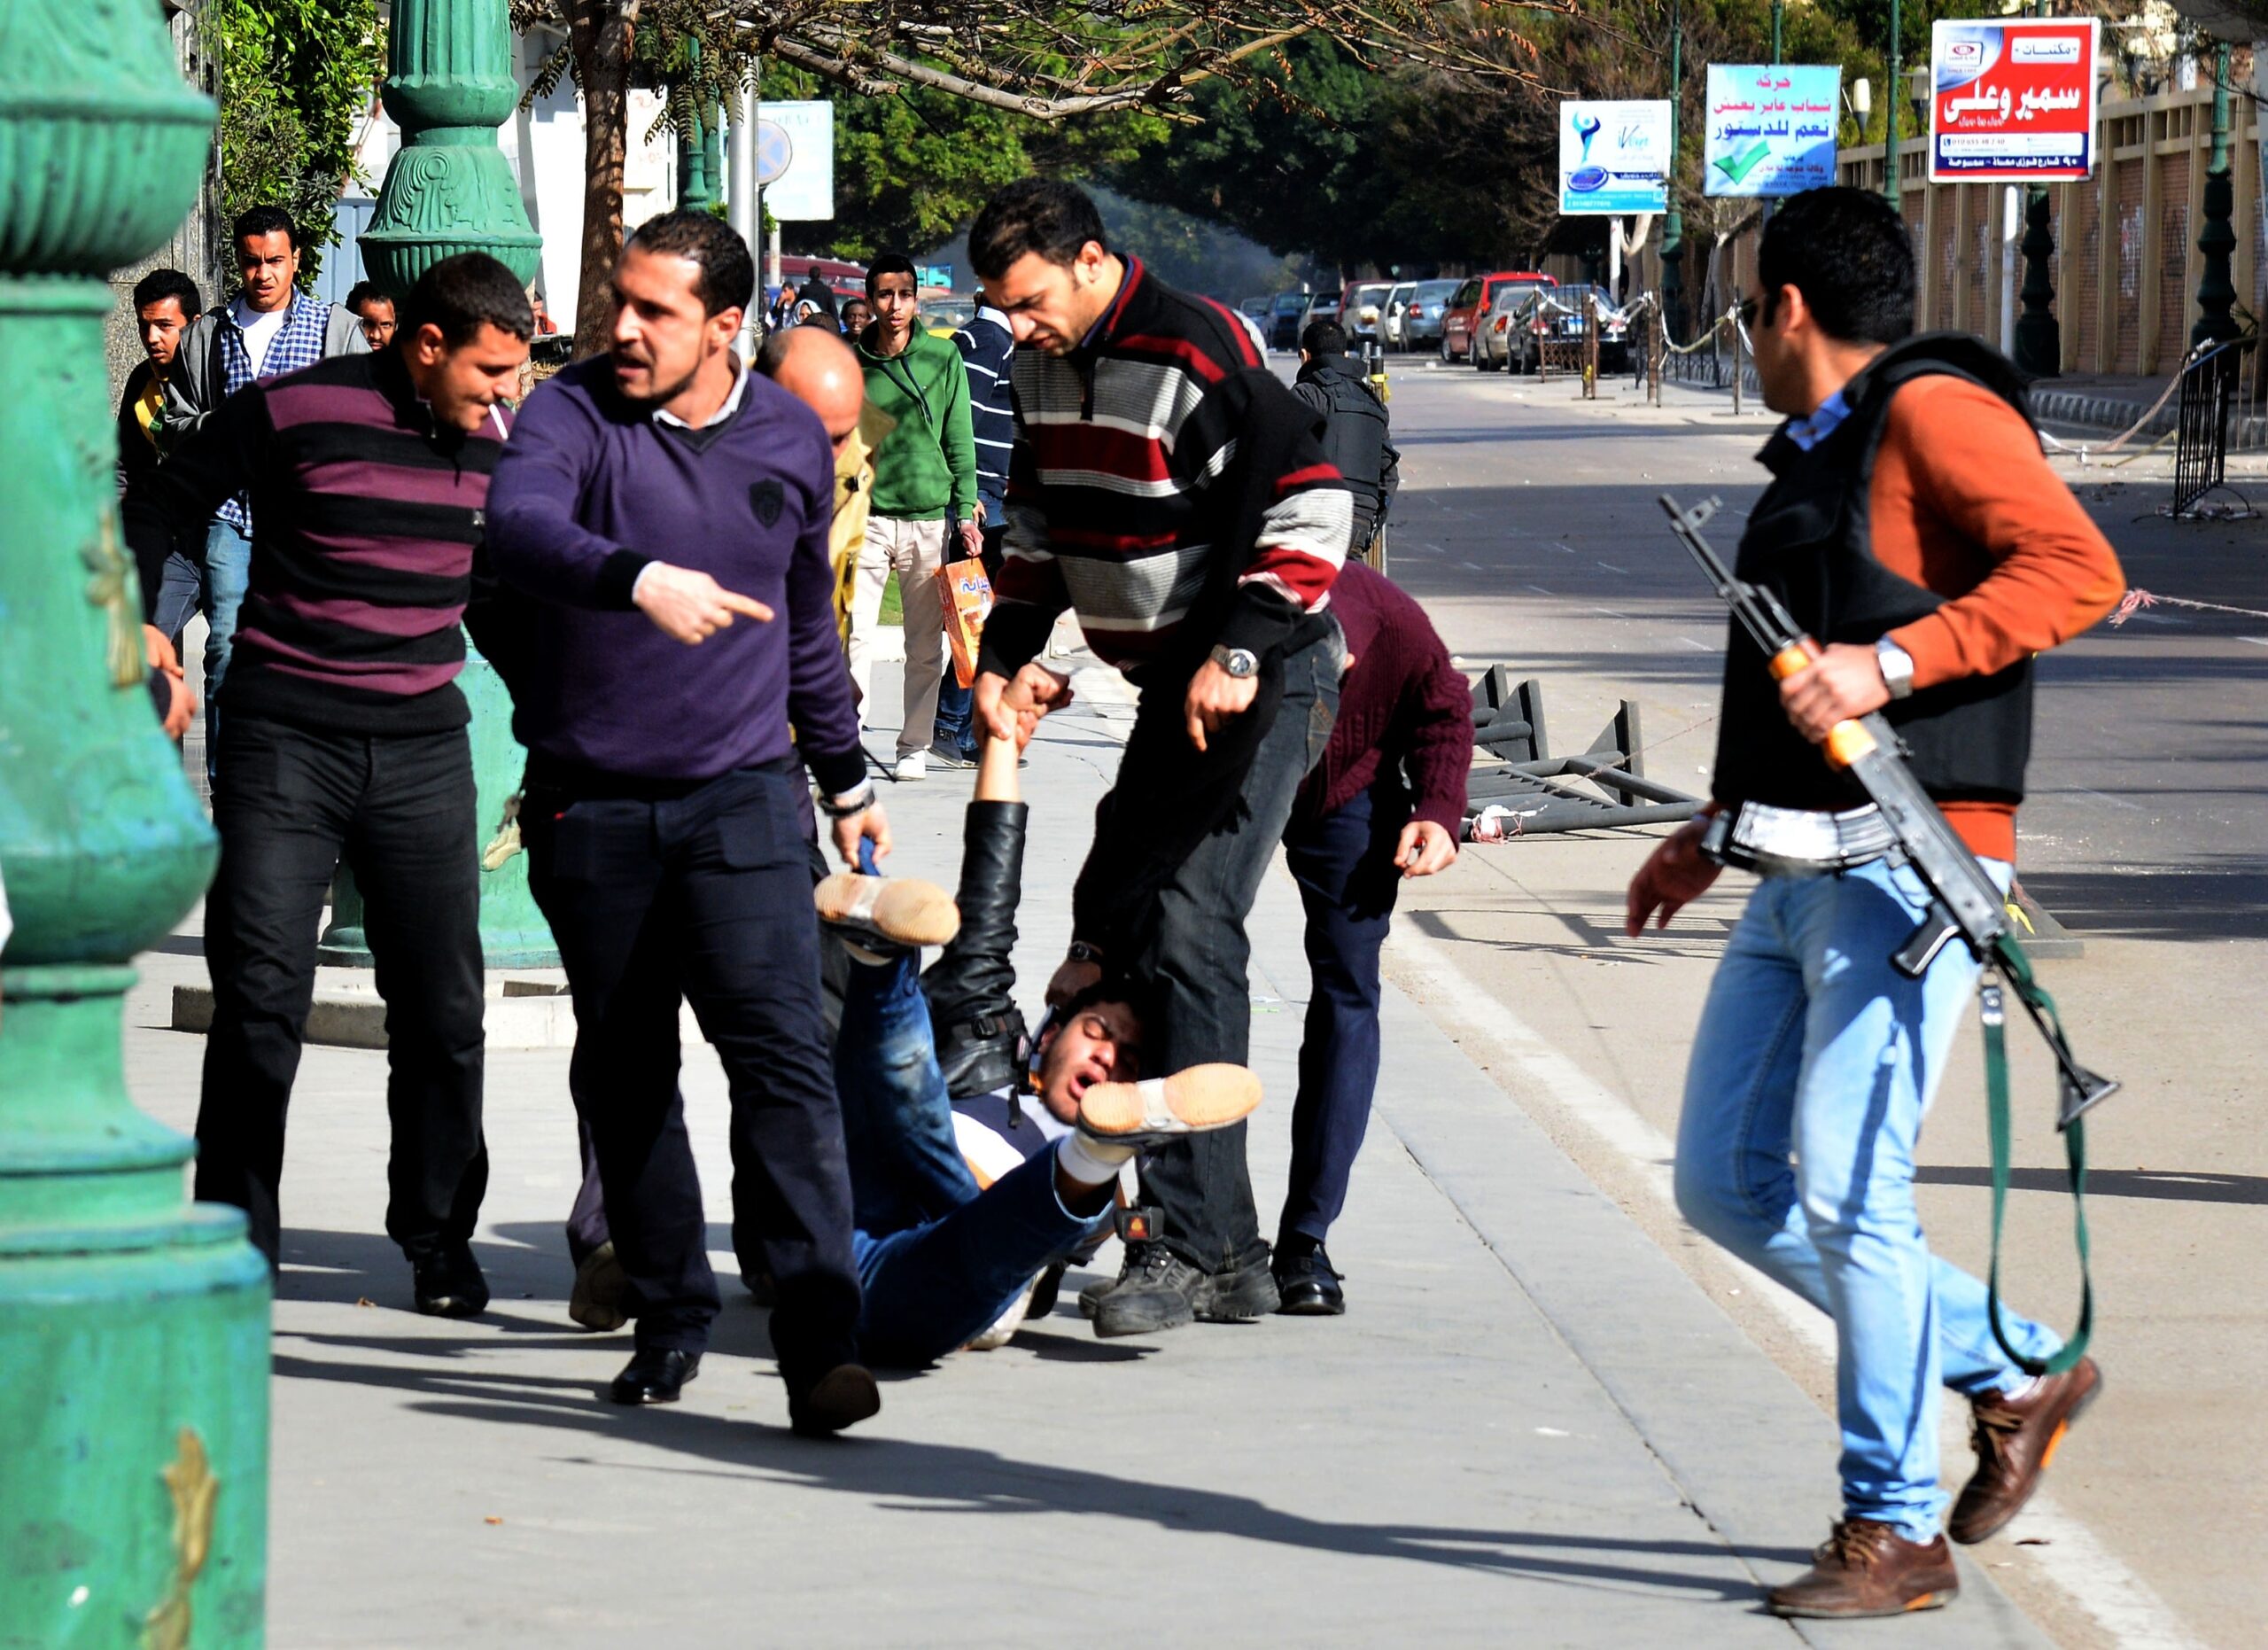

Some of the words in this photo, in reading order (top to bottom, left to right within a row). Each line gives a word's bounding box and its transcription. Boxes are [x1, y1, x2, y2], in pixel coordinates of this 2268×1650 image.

[1756, 73, 1791, 91] حركة
[1790, 97, 1831, 113] شباب
[1944, 77, 2012, 123] وعلى
[2015, 86, 2081, 121] سمير
[1713, 119, 1789, 141] للدستور
[1795, 119, 1829, 143] نعم
